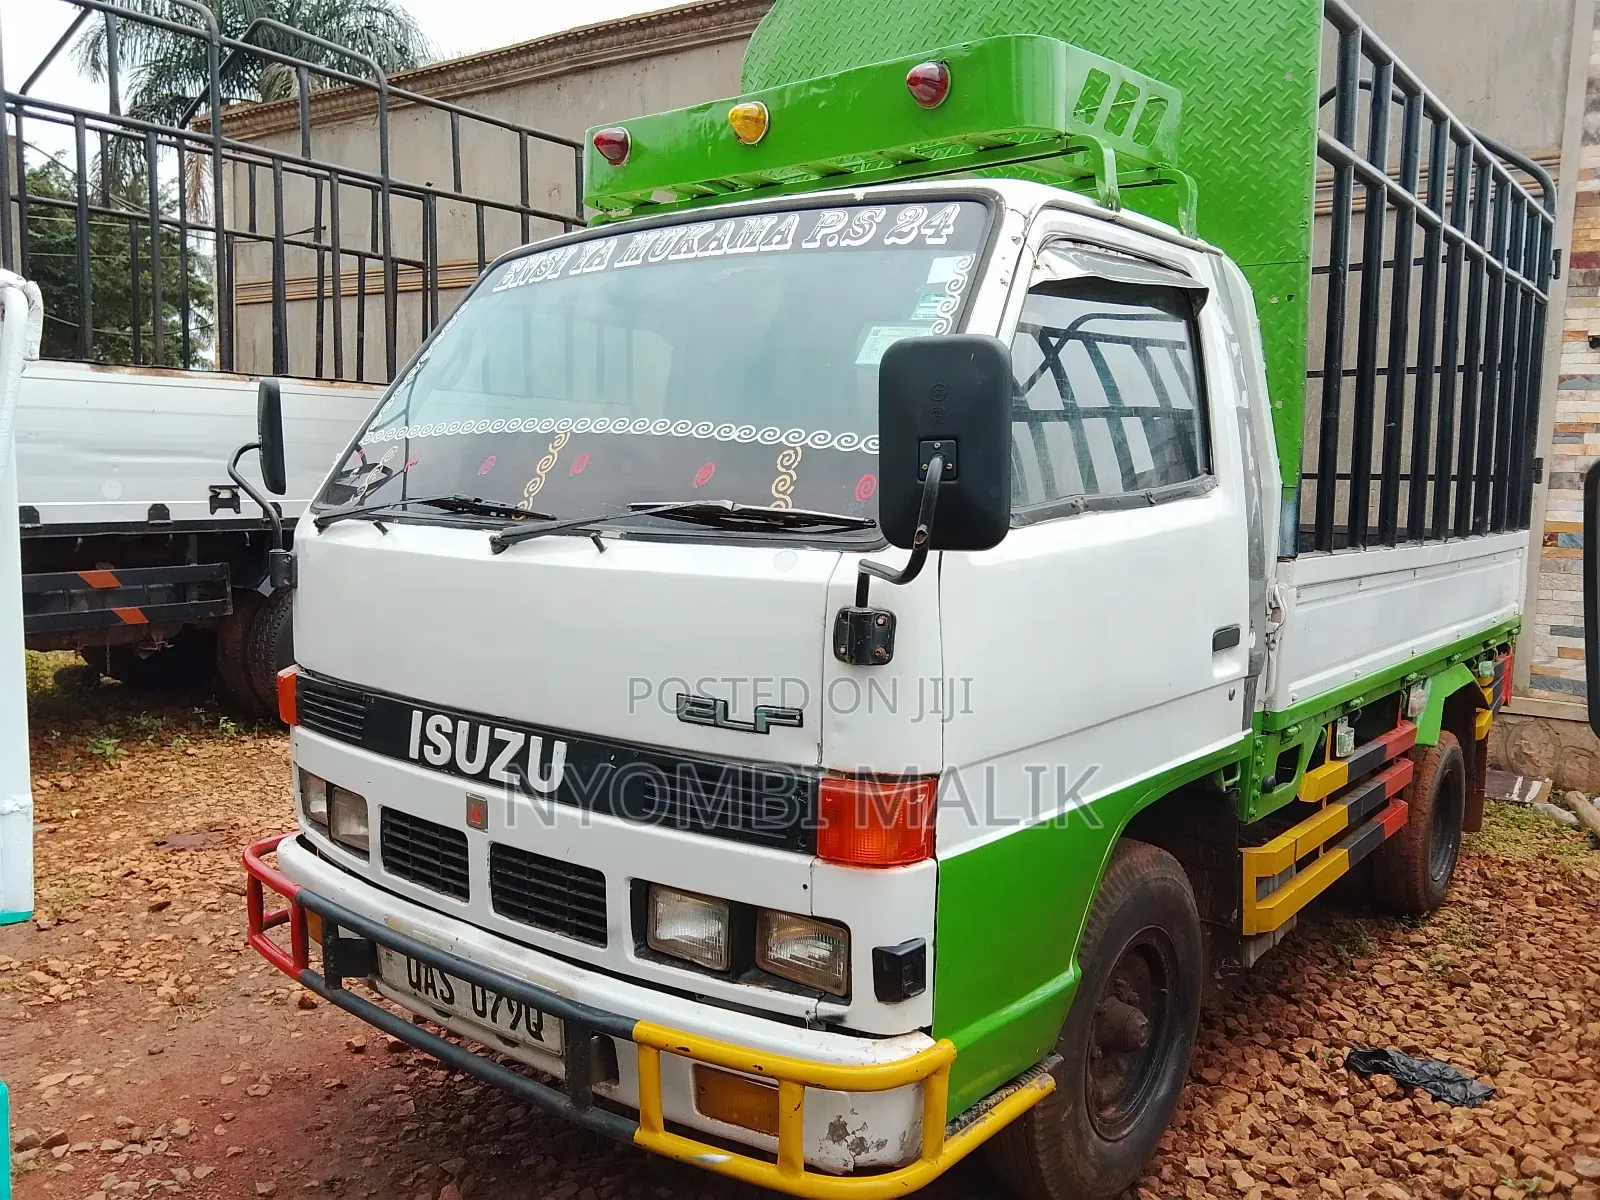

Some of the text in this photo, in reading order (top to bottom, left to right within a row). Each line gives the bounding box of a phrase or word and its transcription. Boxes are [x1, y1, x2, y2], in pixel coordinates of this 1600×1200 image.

[569, 238, 618, 276] YA
[613, 213, 800, 269] MUKAMA
[801, 206, 887, 248] P.S
[884, 204, 961, 246] 24
[675, 692, 804, 735] ELF
[408, 709, 568, 793] ISUZU
[407, 956, 455, 1005] UAS
